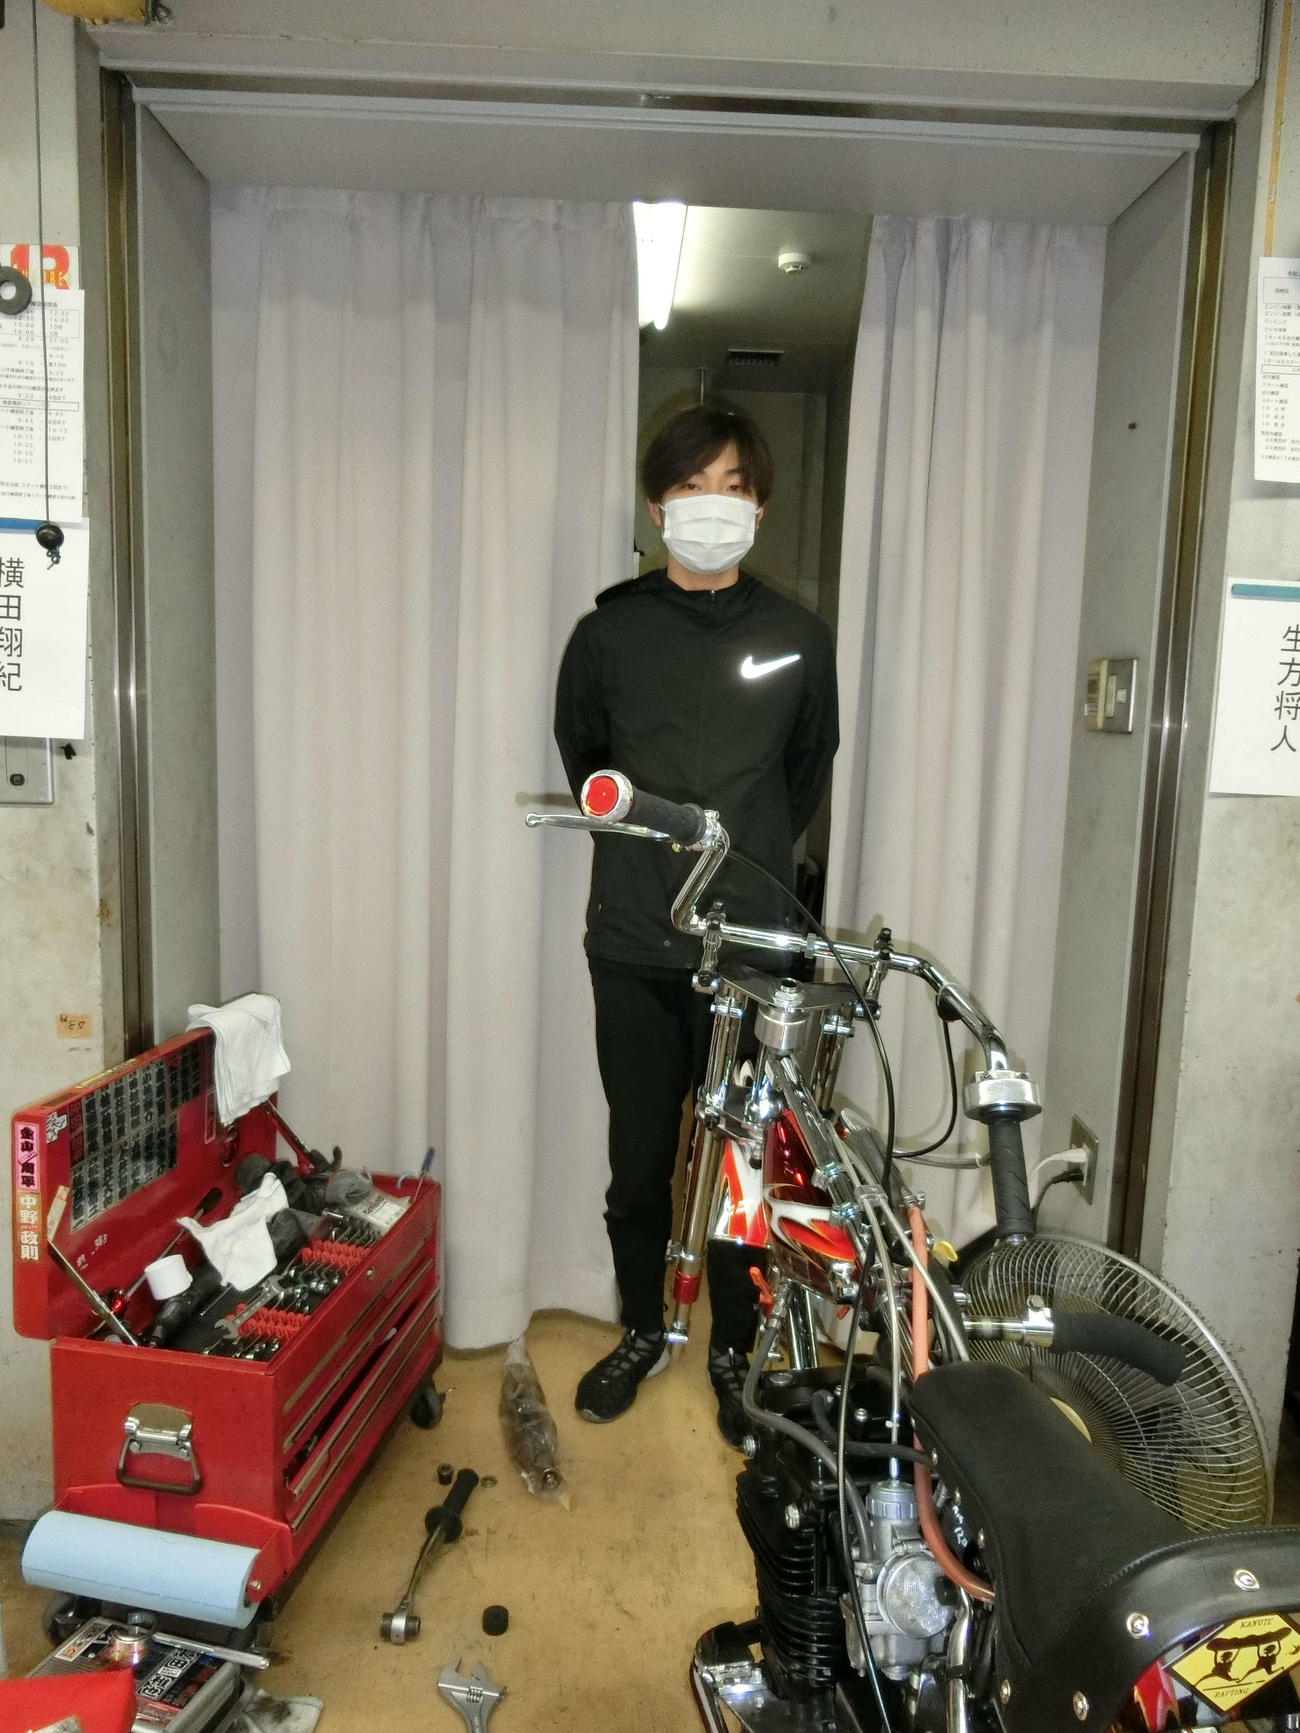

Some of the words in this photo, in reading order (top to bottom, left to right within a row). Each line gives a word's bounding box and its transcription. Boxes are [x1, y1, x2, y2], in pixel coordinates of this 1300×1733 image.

[0, 556, 24, 692] 横田翔紀
[1271, 624, 1300, 752] 生方将人
[1239, 1617, 1274, 1629] KANUTE
[1213, 1687, 1250, 1699] RAFTING
